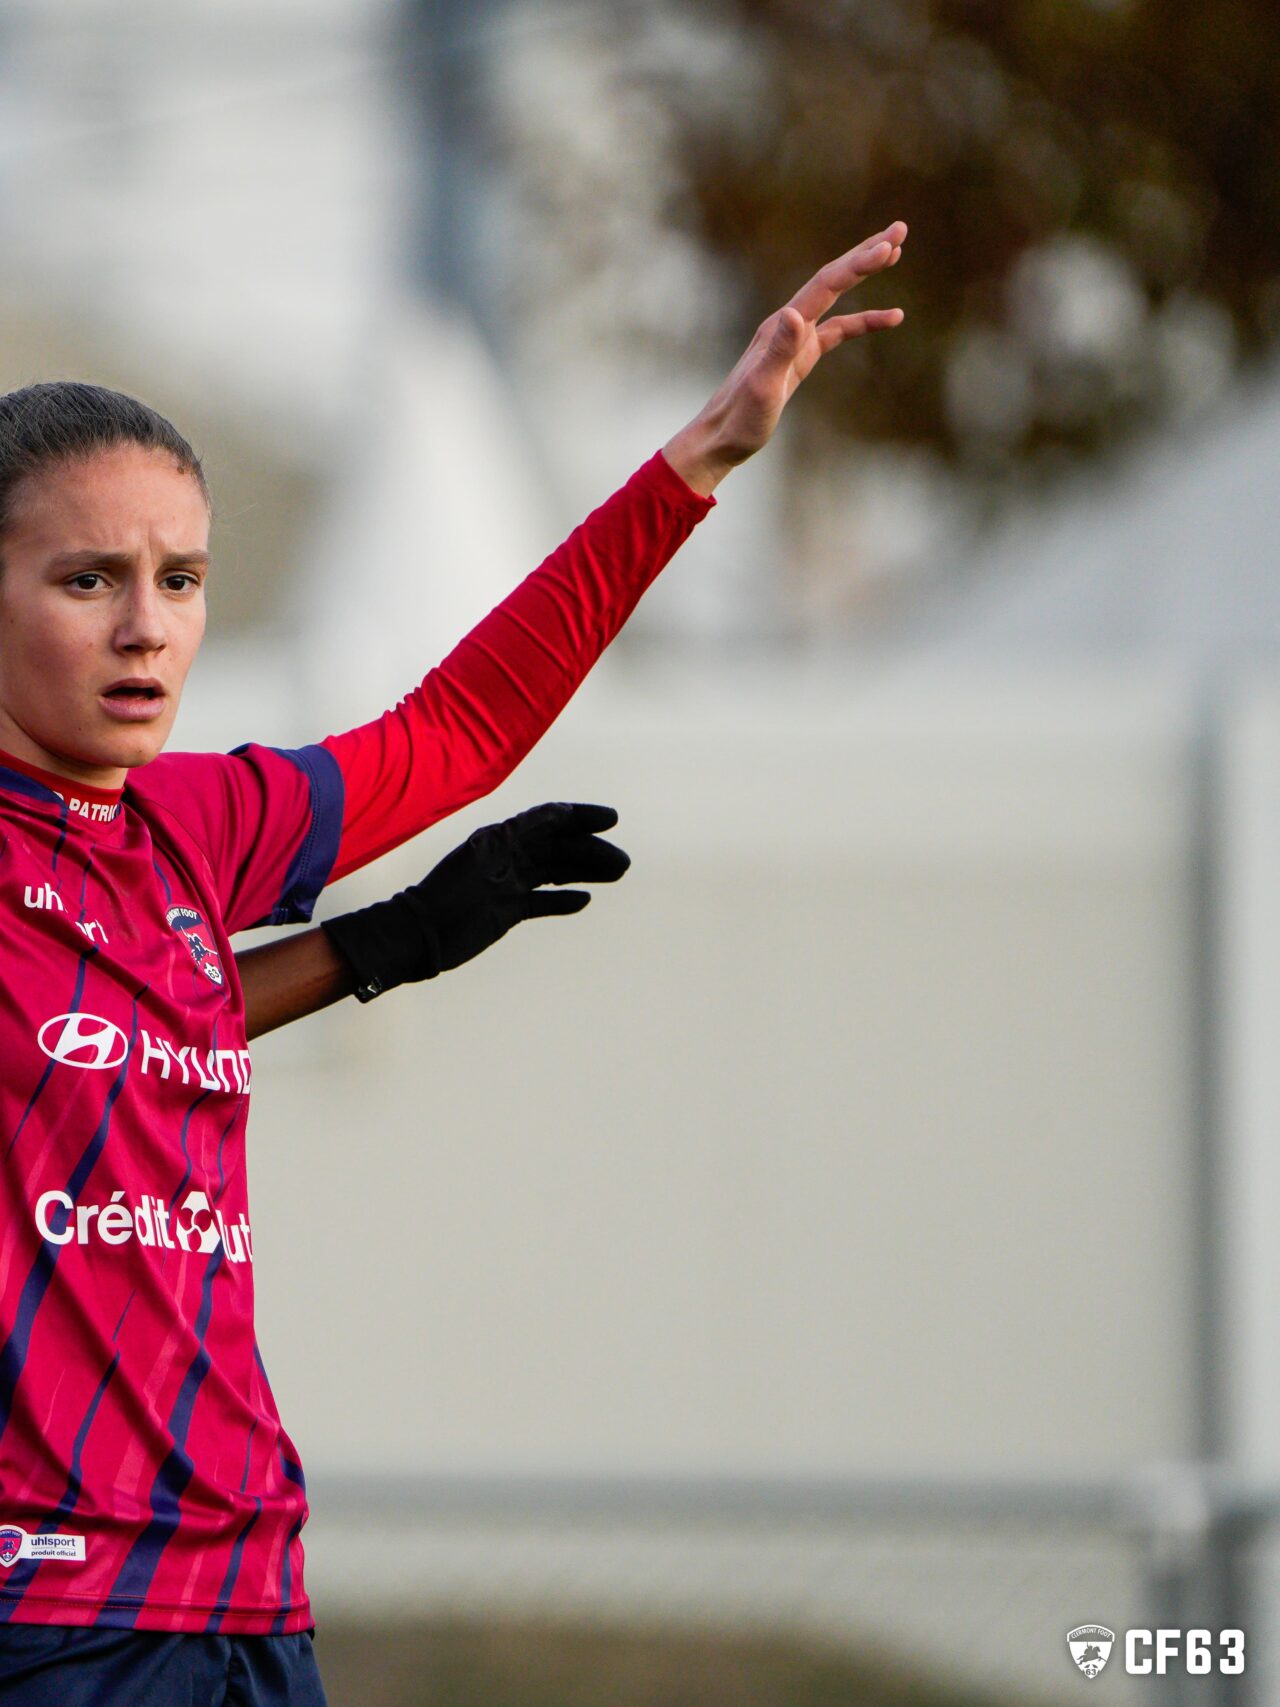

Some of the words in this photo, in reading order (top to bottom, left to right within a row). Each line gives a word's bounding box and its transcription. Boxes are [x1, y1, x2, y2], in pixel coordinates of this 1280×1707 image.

[35, 1190, 175, 1249] Crédit
[31, 1536, 76, 1548] uhlsport
[31, 1549, 56, 1557] produit
[56, 1549, 77, 1557] officiel
